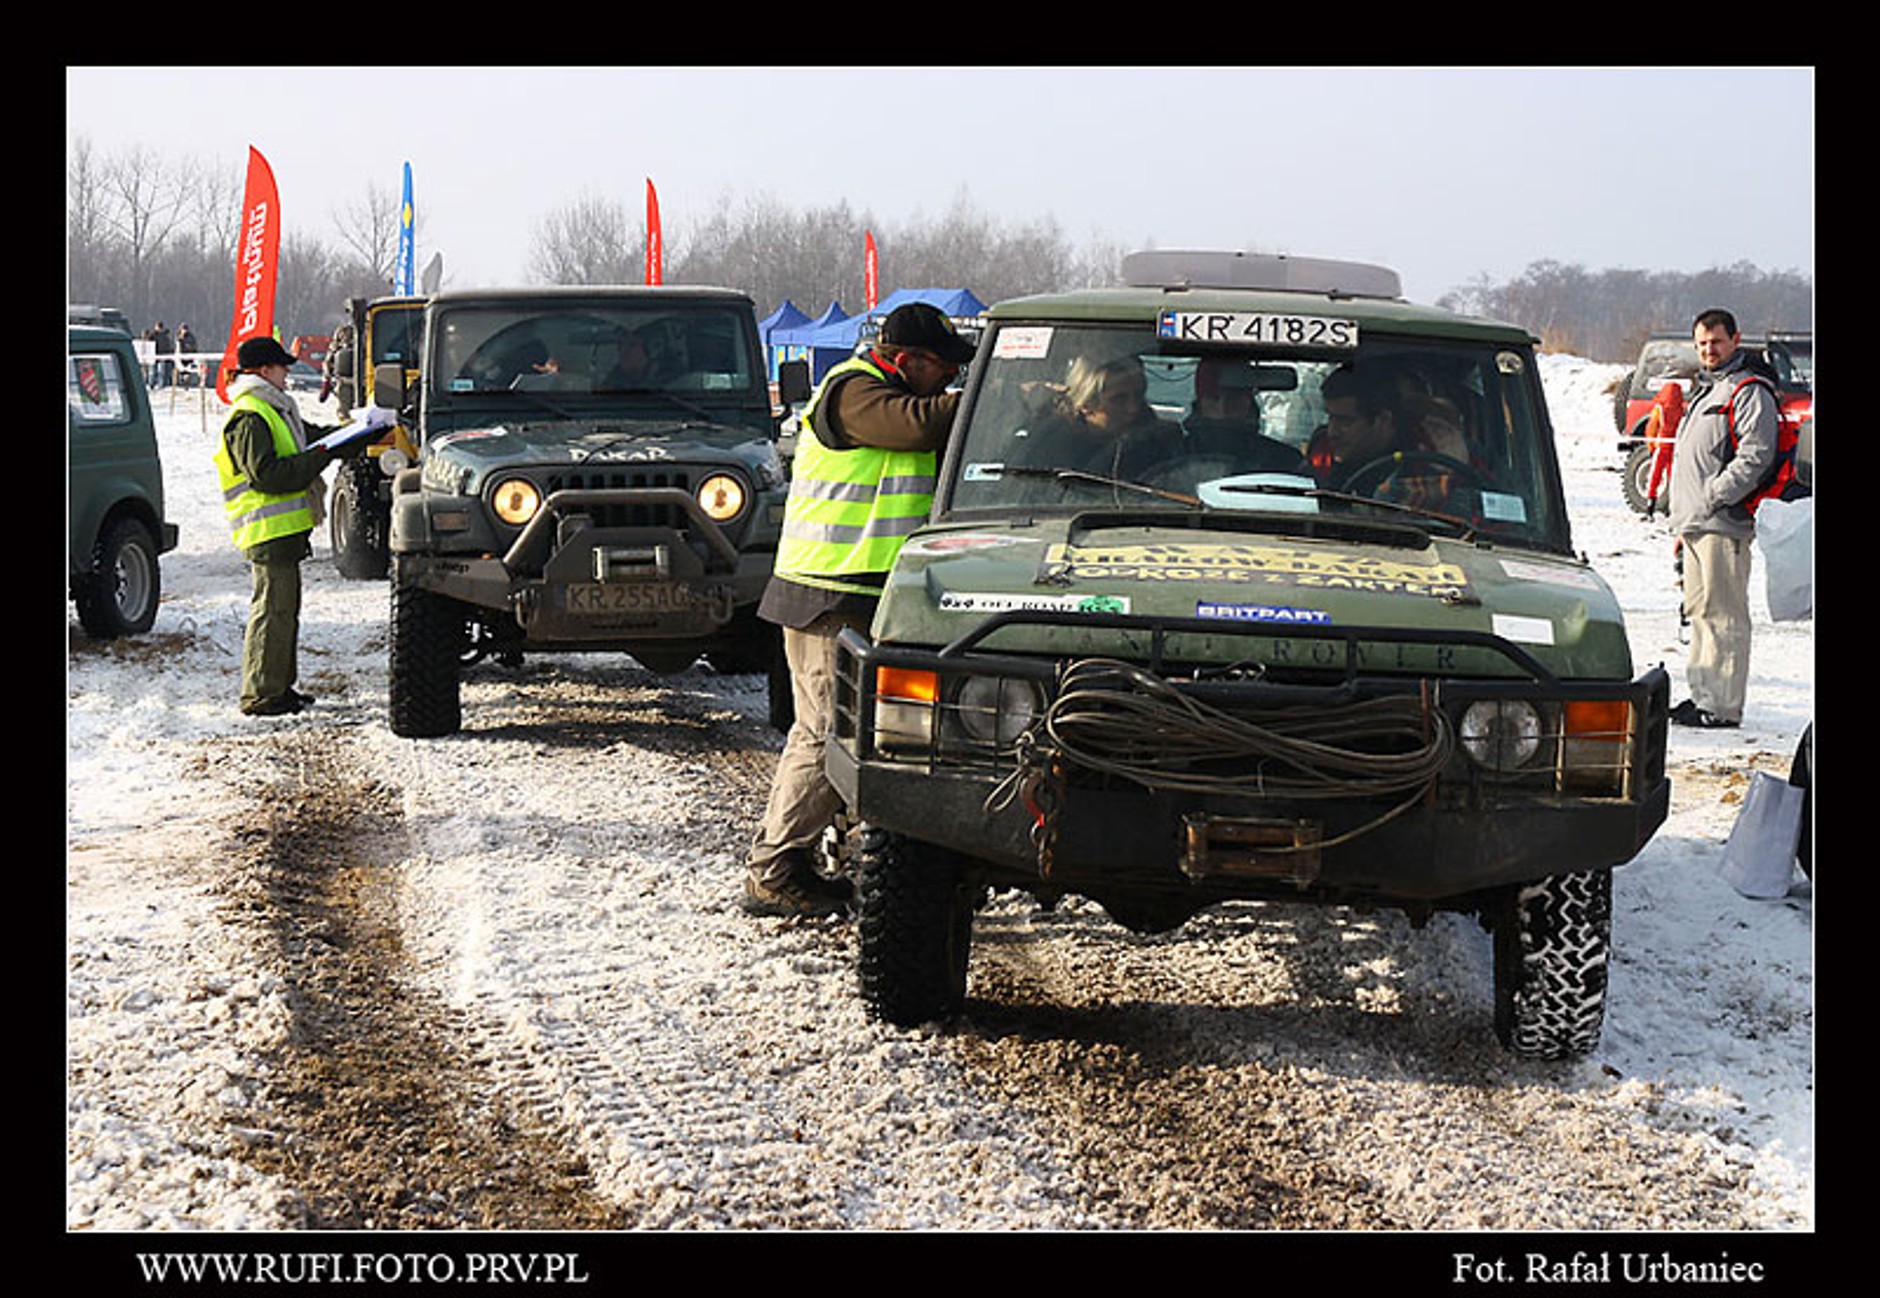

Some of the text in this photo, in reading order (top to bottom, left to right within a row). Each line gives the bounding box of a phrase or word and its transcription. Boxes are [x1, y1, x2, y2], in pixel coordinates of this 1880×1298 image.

[1182, 315, 1351, 345] KR 4182S
[570, 587, 609, 609] KR
[1198, 605, 1328, 622] BRITPART
